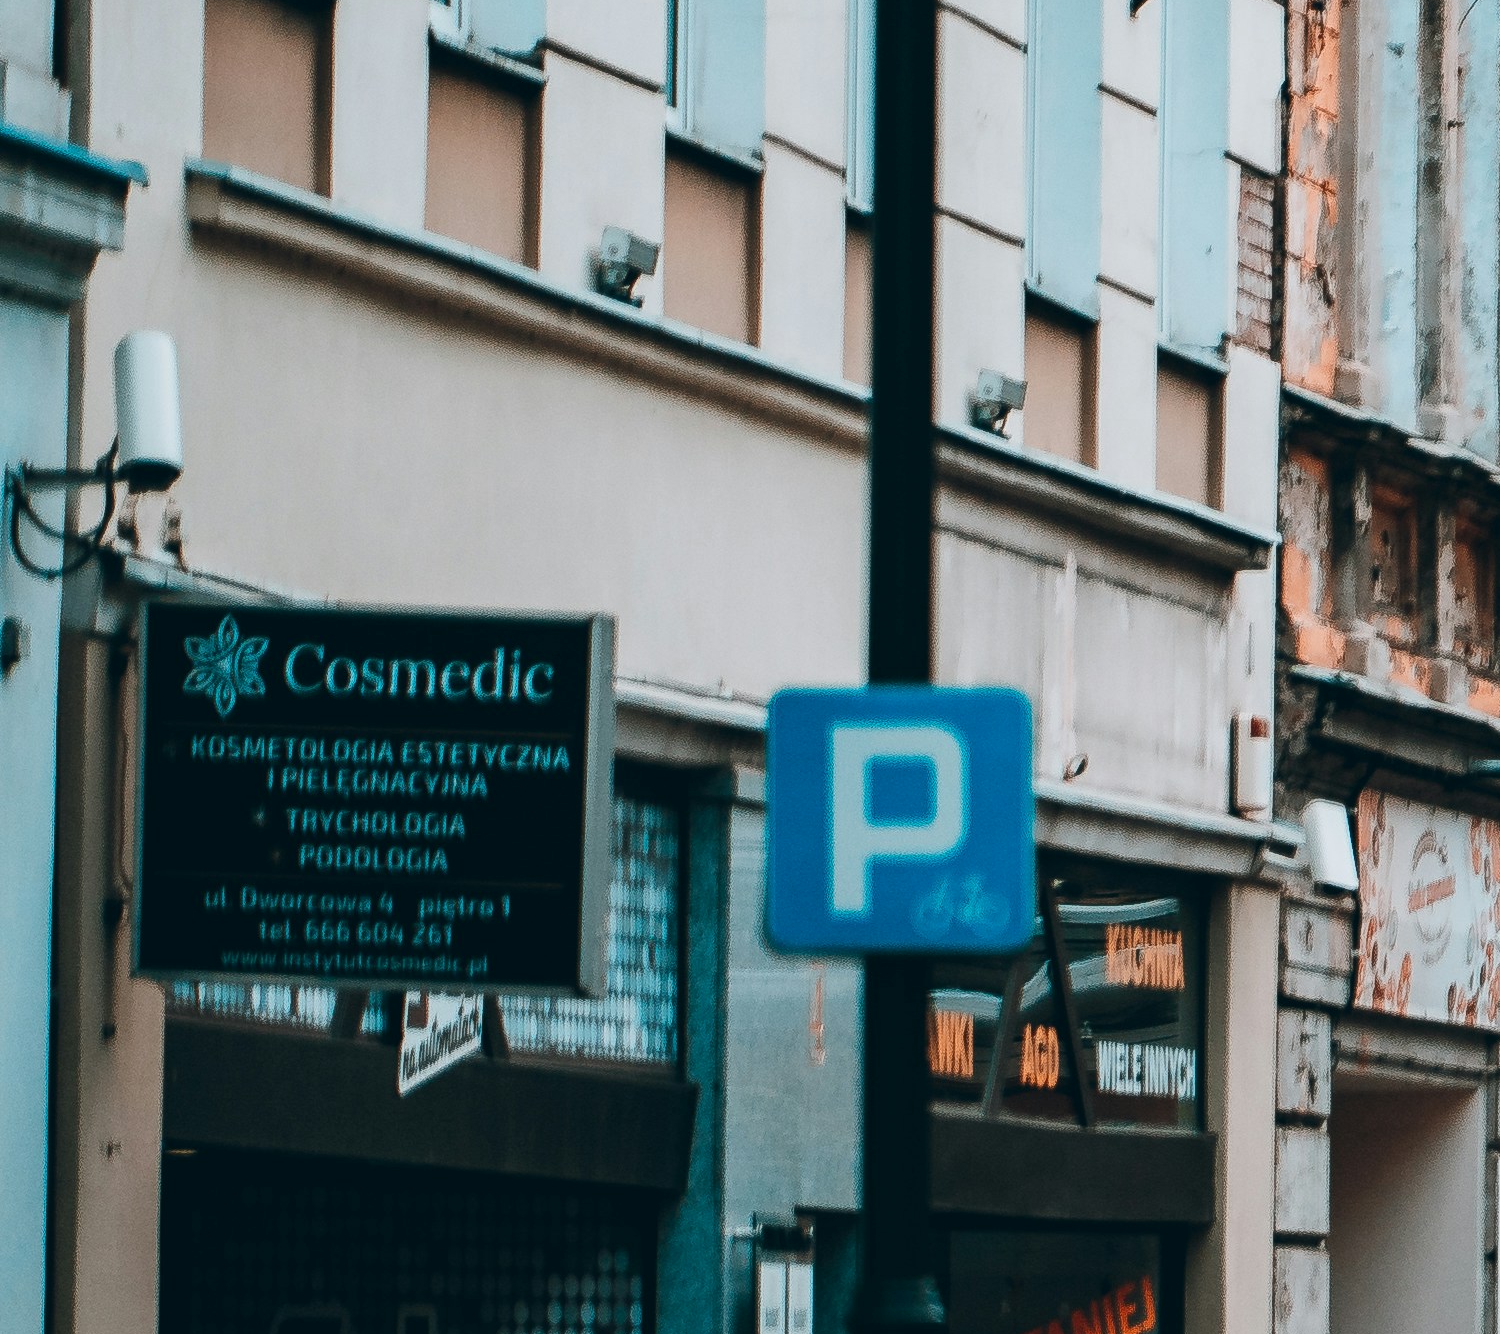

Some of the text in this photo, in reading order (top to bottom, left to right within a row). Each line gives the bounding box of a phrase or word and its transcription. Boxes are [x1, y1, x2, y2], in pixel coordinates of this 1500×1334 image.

[284, 643, 556, 704] Cosmedic
[190, 734, 571, 772] KOSMETOLOGIA ESTETYCZNA
[286, 807, 466, 839] TRYCHOLOGIA
[830, 724, 967, 918] P
[299, 843, 449, 873] PODOLOGIA
[239, 884, 372, 914] Dworcowa
[303, 920, 350, 946] 666
[355, 921, 404, 947] 604
[411, 922, 454, 949] 261
[1021, 1022, 1060, 1090] AGD
[1097, 1039, 1196, 1100] WIELE INNYCH
